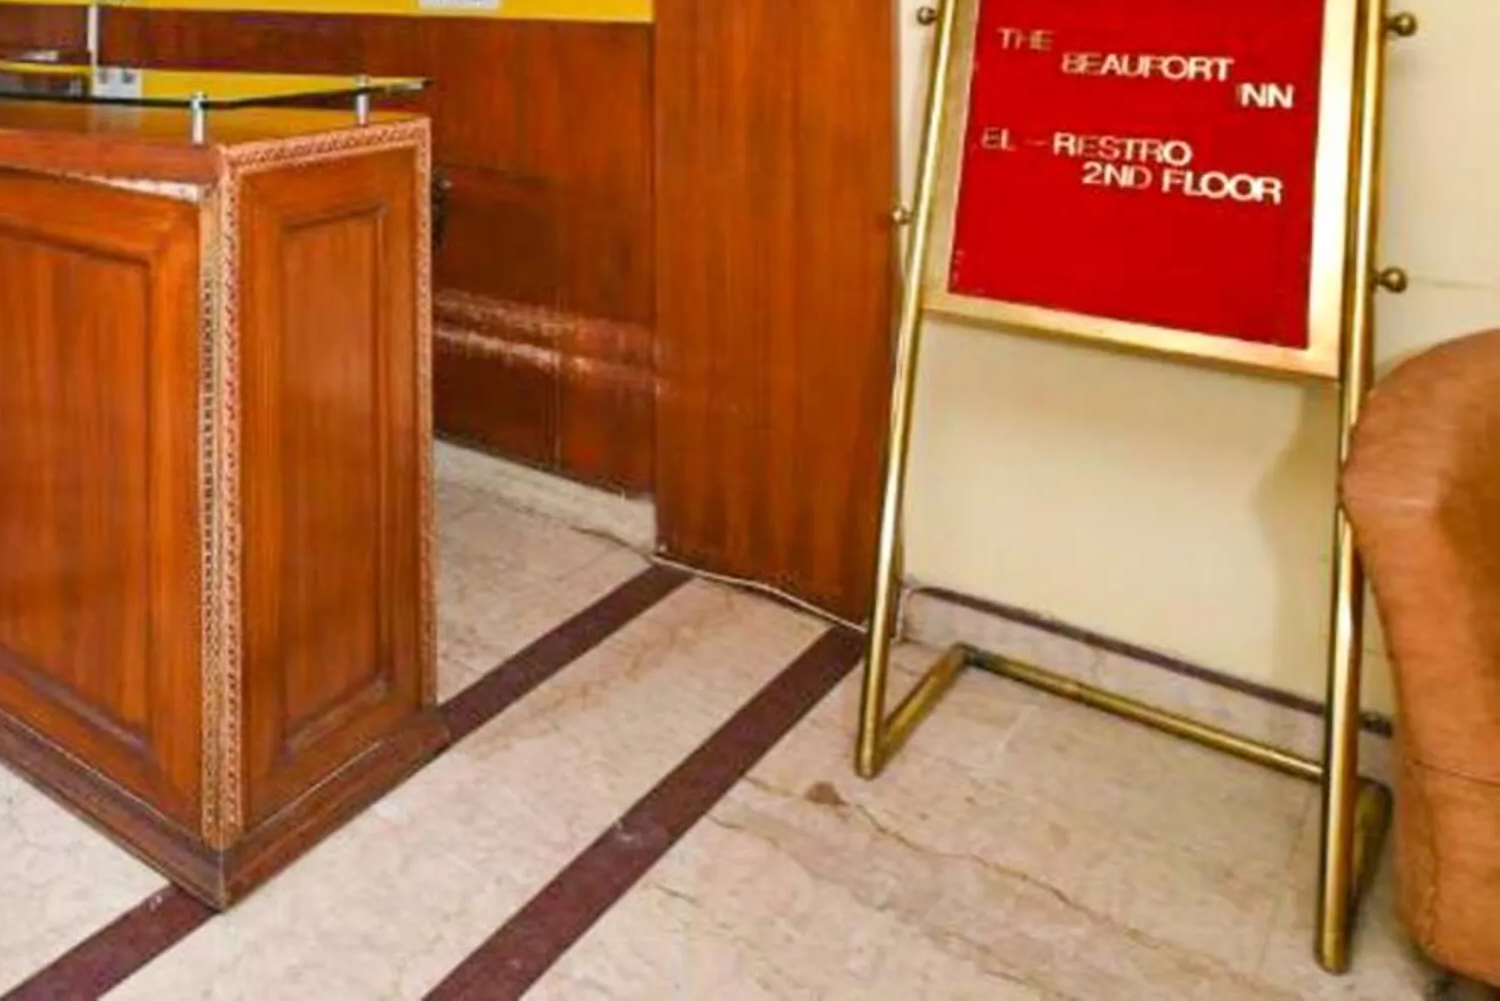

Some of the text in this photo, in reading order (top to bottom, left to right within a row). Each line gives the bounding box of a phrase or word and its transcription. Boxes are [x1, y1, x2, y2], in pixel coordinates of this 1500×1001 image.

[998, 27, 1054, 51] THE
[1061, 53, 1233, 81] BEAUFORT
[981, 127, 1016, 150] EL
[1053, 131, 1193, 167] RESTRO
[1082, 161, 1284, 205] 2ND FLOOR
